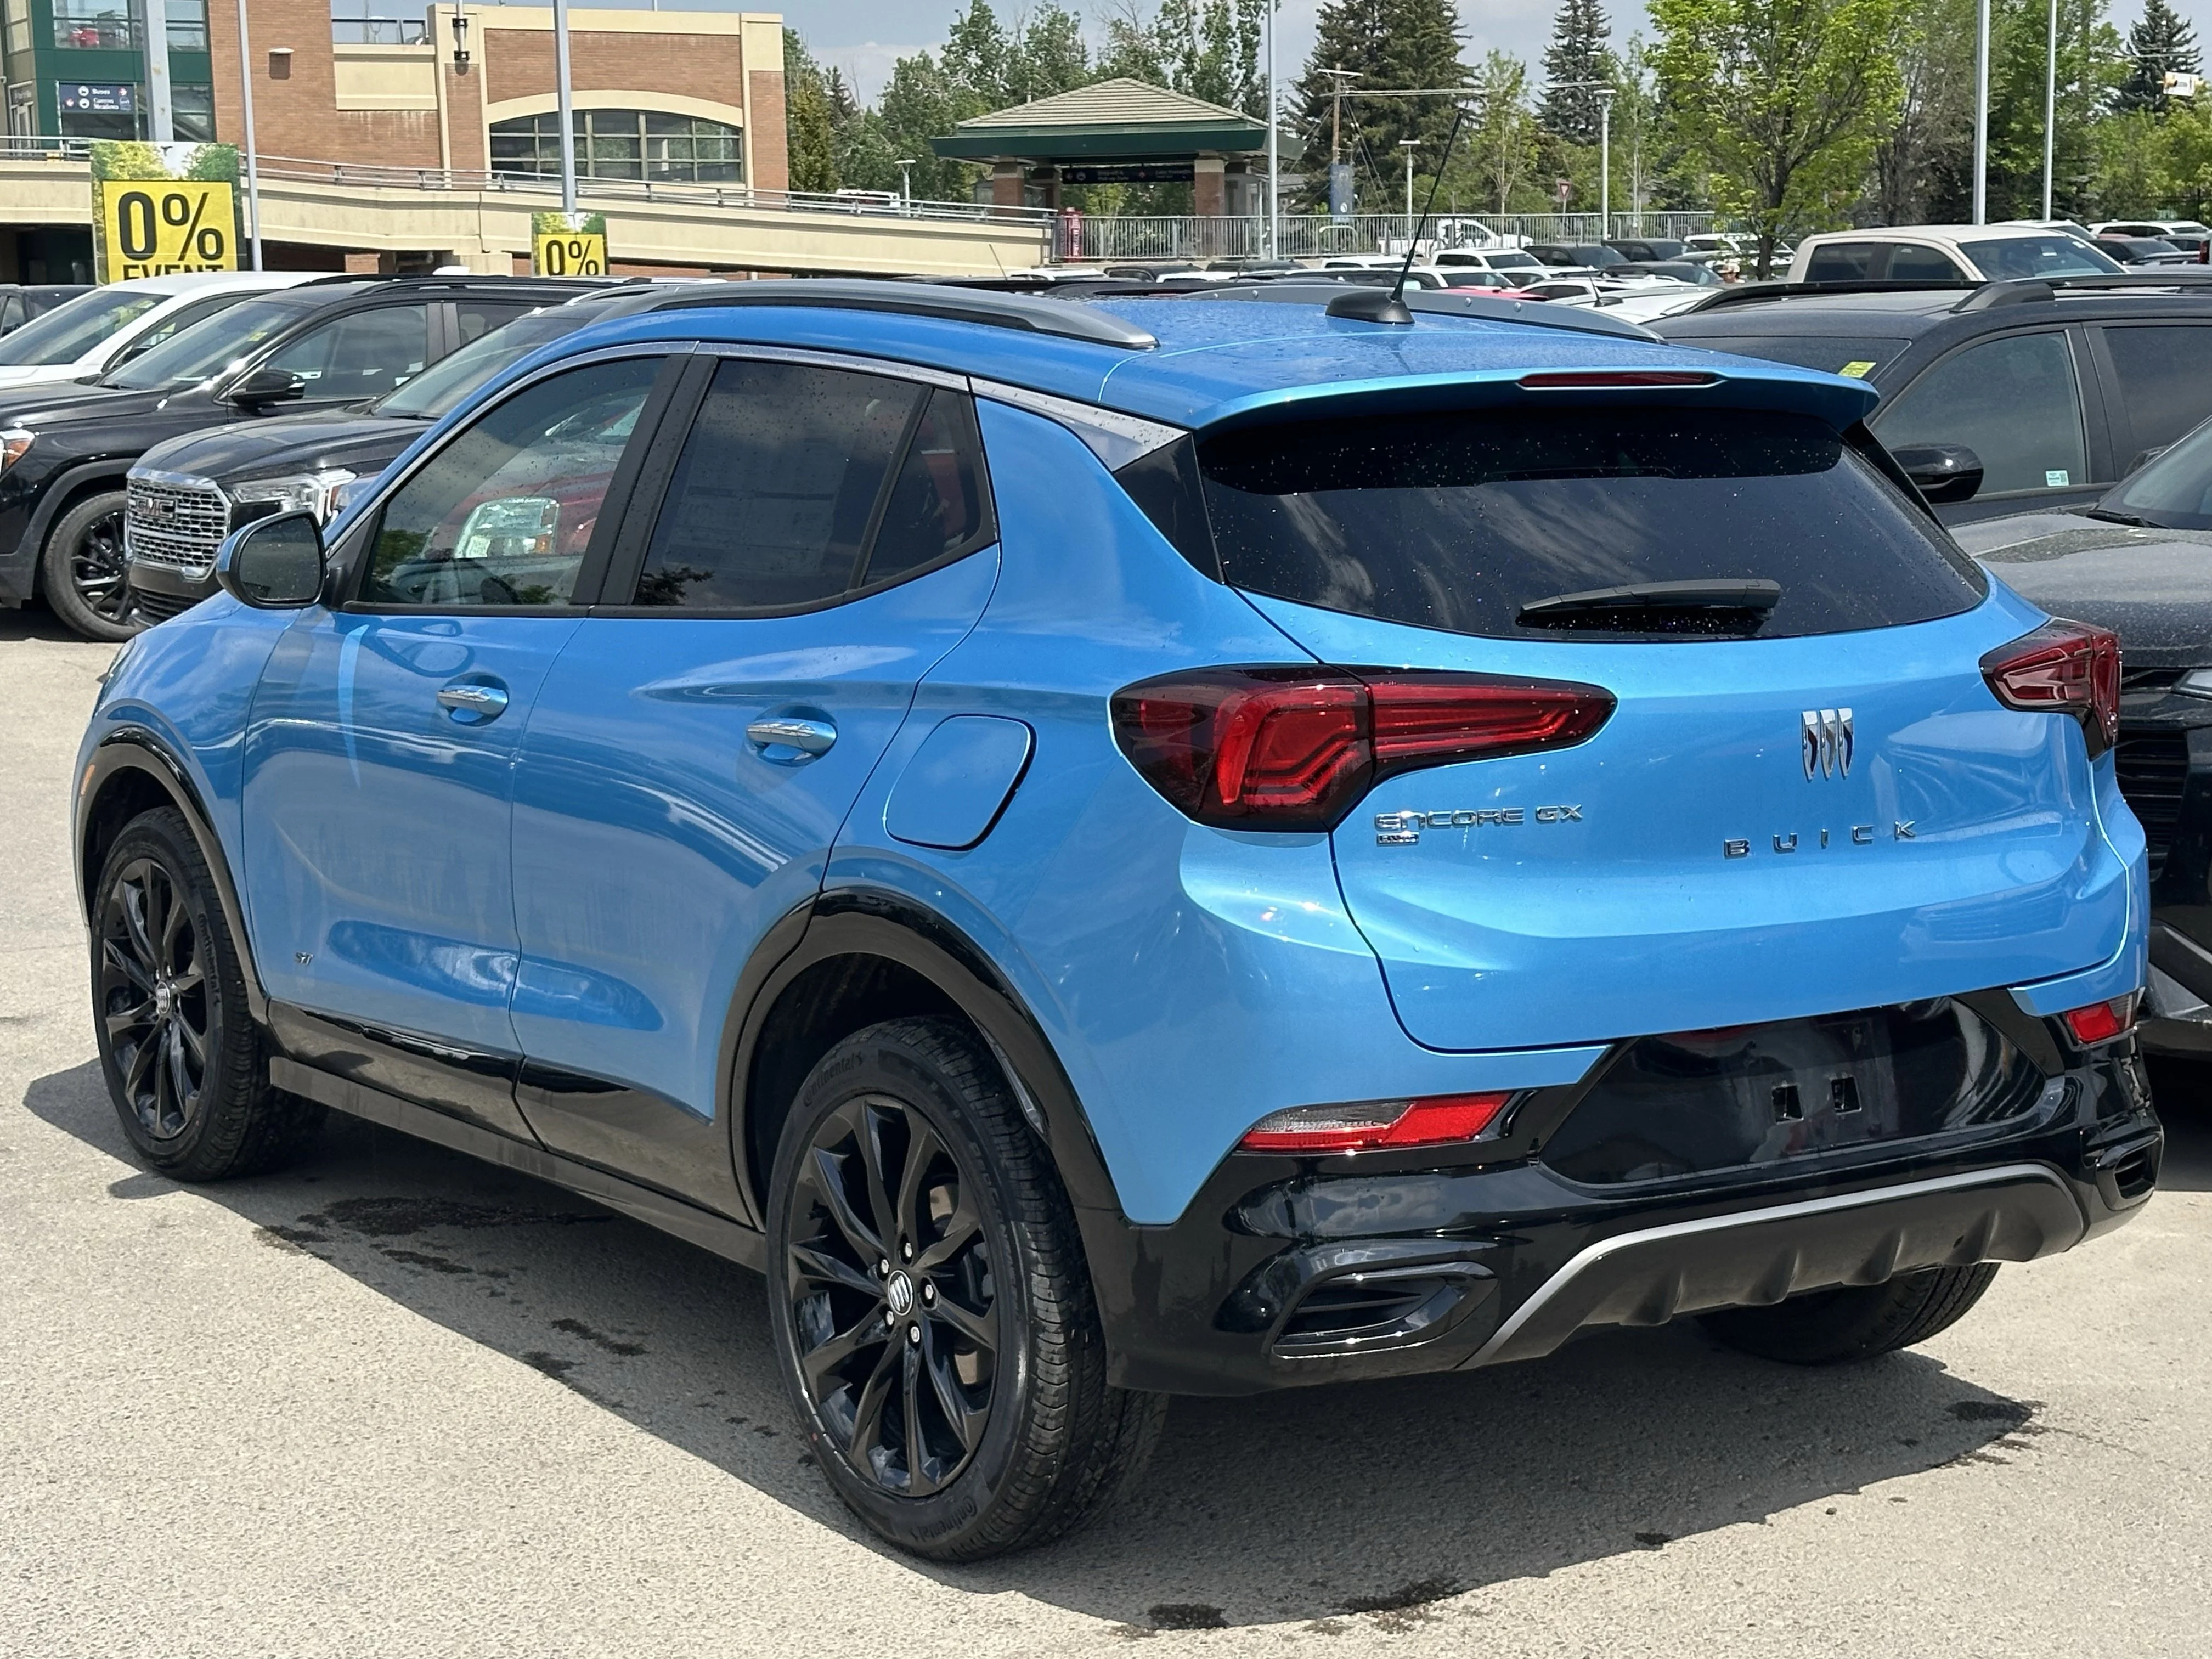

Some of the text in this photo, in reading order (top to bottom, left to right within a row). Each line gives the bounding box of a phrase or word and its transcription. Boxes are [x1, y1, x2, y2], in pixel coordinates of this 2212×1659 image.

[118, 191, 224, 261] 0%
[546, 240, 599, 275] 0%
[1375, 804, 1583, 831] ENCORE GX
[1724, 820, 1916, 859] BUICK
